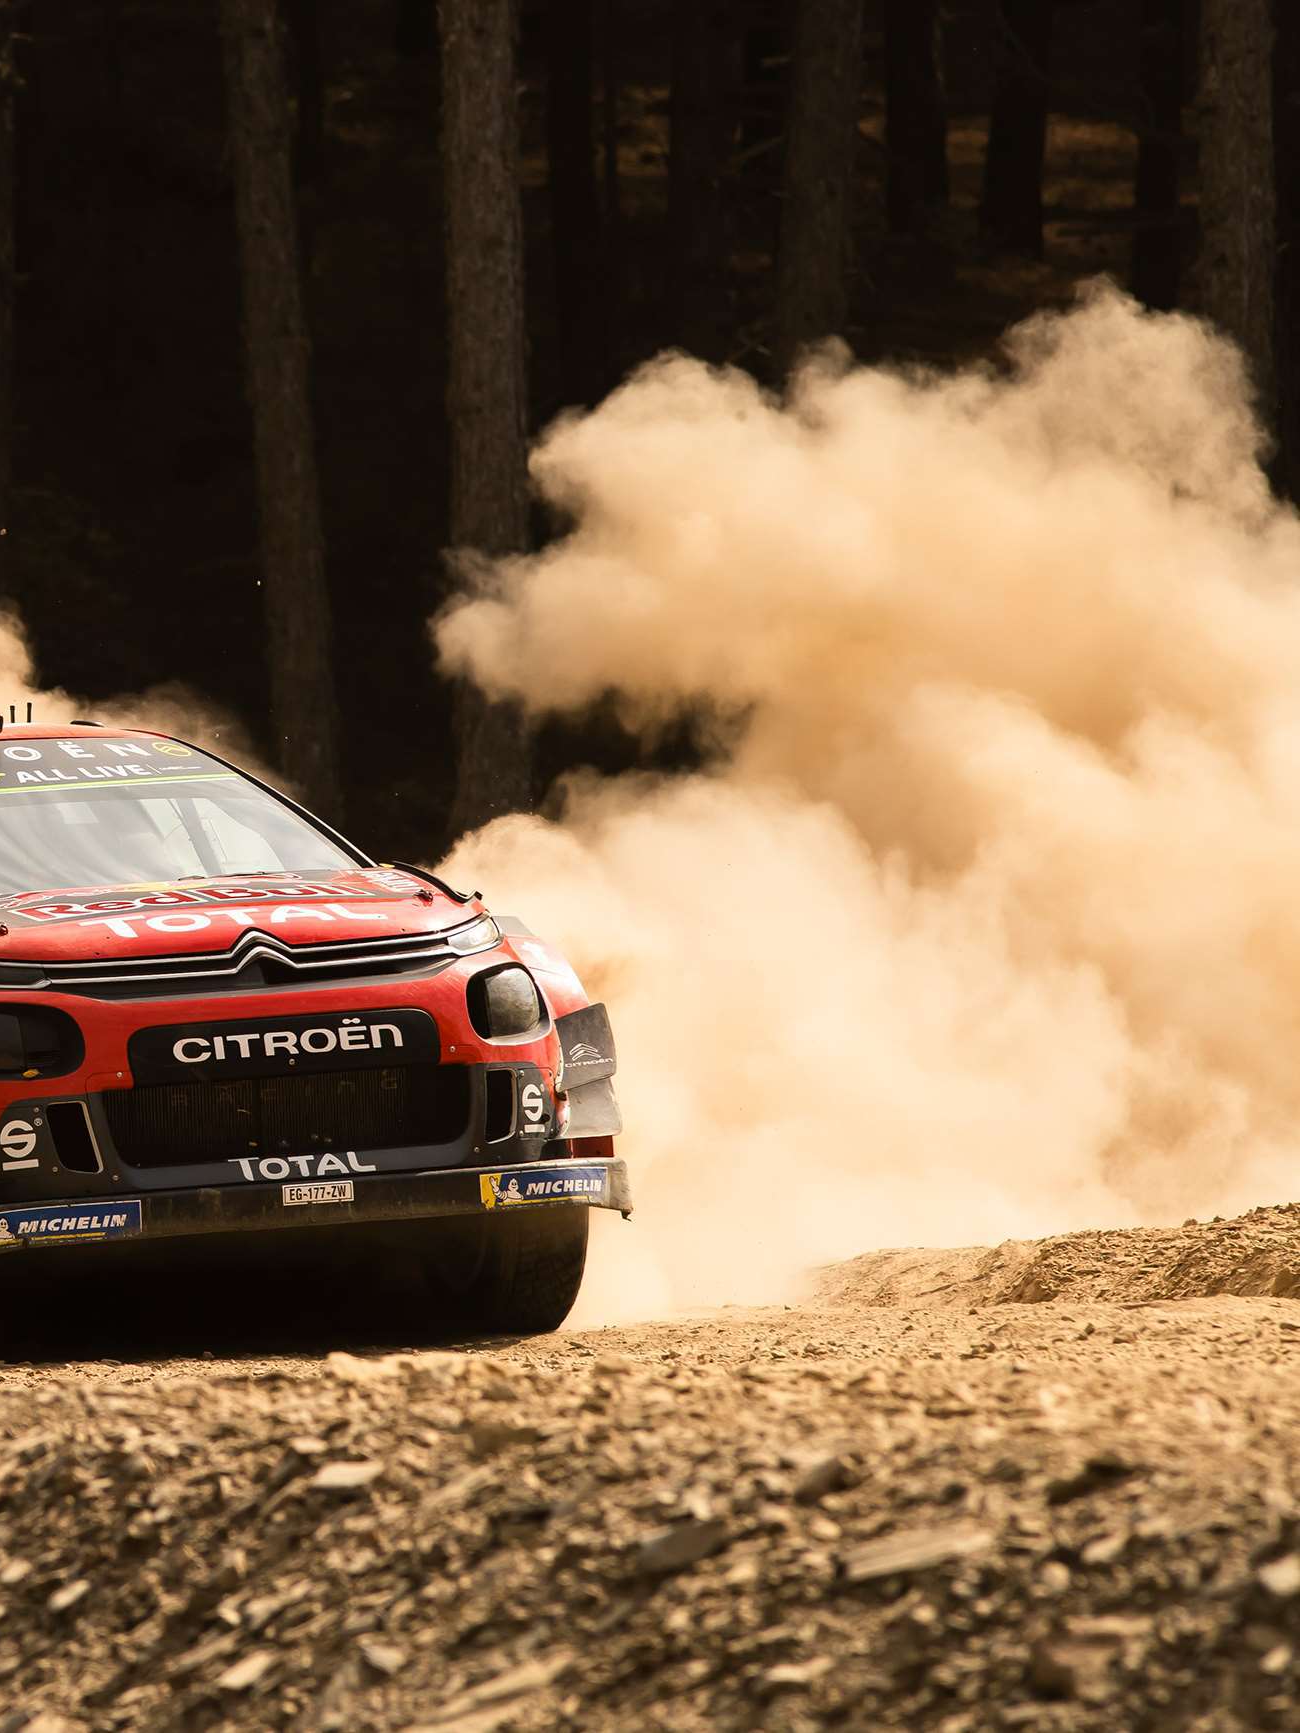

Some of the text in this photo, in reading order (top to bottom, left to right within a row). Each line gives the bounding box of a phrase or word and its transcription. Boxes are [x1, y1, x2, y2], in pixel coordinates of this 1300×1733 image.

[16, 769, 77, 783] ALL
[77, 764, 152, 779] LIVE
[7, 882, 376, 921] Red Bull
[78, 903, 388, 938] TOTAL
[227, 1151, 377, 1181] TOTAL
[289, 1185, 347, 1201] EG-177-ZW
[526, 1179, 603, 1196] MICHELIN
[17, 1213, 128, 1234] MICHELIN
